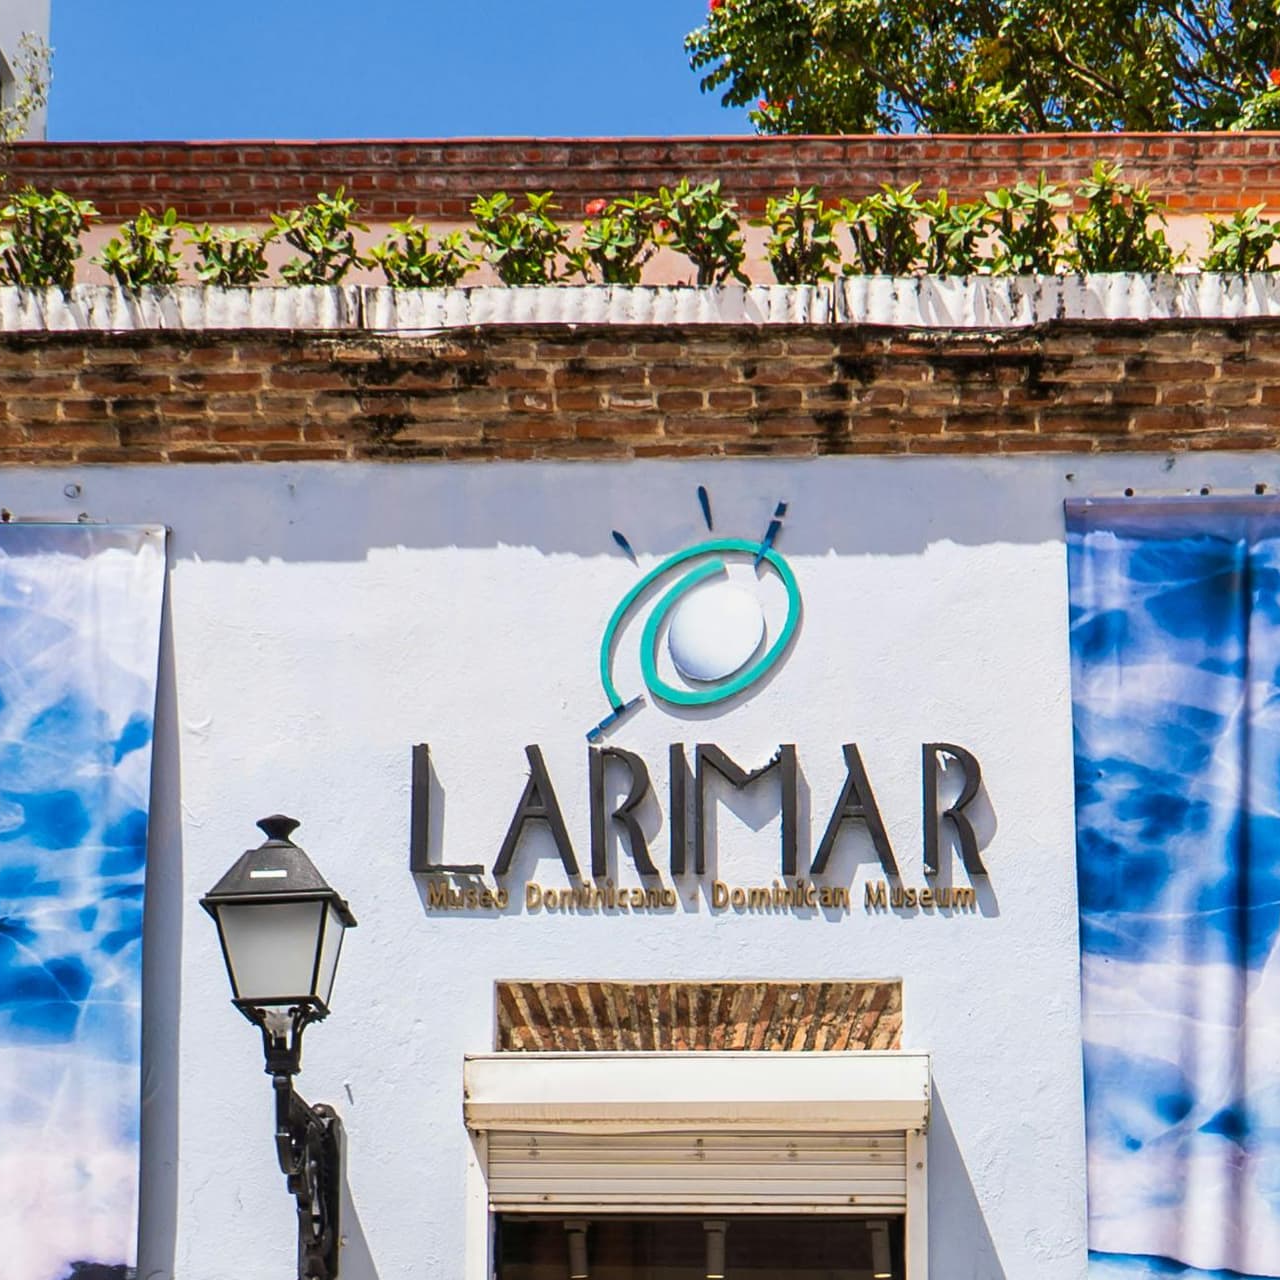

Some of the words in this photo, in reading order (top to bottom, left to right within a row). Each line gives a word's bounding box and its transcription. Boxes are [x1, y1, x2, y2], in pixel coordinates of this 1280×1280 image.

[409, 742, 988, 876] LARIMAR
[426, 880, 509, 910] Museo
[526, 880, 676, 909] Dominicano
[712, 880, 850, 911] Dominican
[864, 881, 977, 910] Museum
